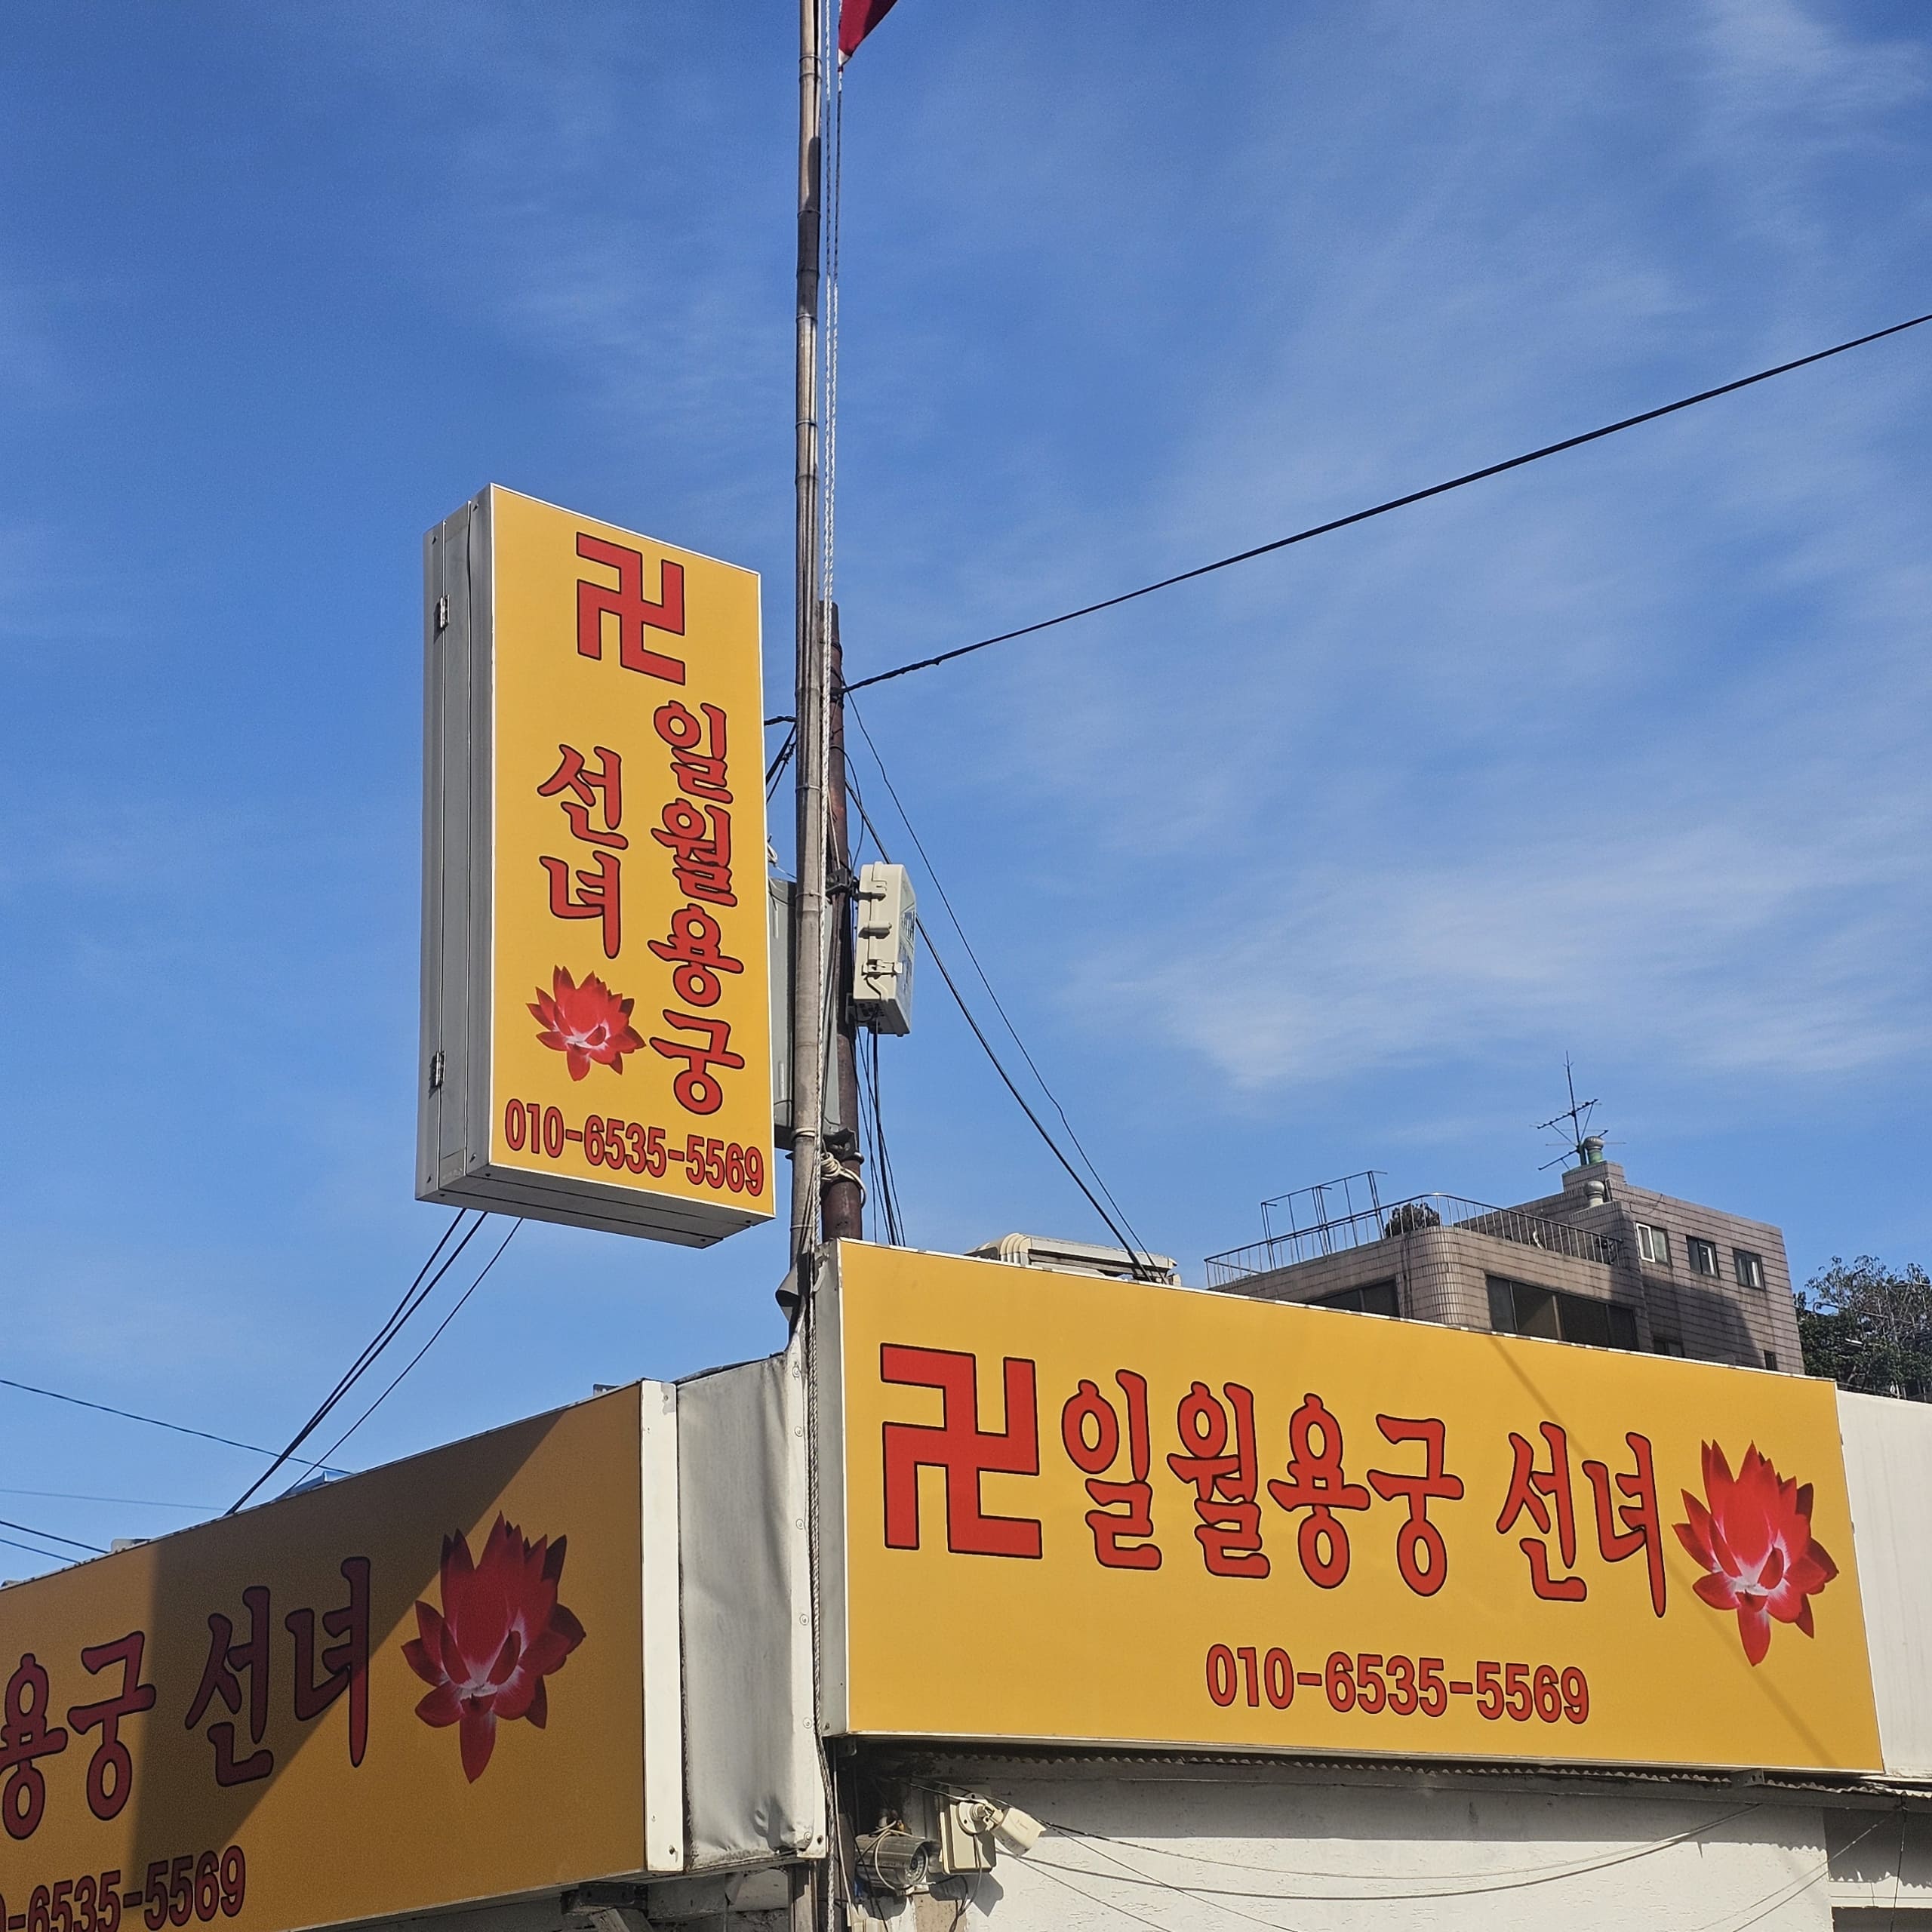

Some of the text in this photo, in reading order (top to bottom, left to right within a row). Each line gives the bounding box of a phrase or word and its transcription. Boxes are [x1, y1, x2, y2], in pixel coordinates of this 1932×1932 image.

[536, 743, 629, 959] 선녀
[648, 700, 745, 1115] 일월용궁
[504, 1097, 764, 1198] 010-6535-5569
[1060, 1368, 1667, 1618] 일월용궁 선녀
[184, 1556, 371, 1788] 선녀
[1205, 1643, 1590, 1725] 010-6535-5569
[0, 1844, 246, 1932] -6535-5569
